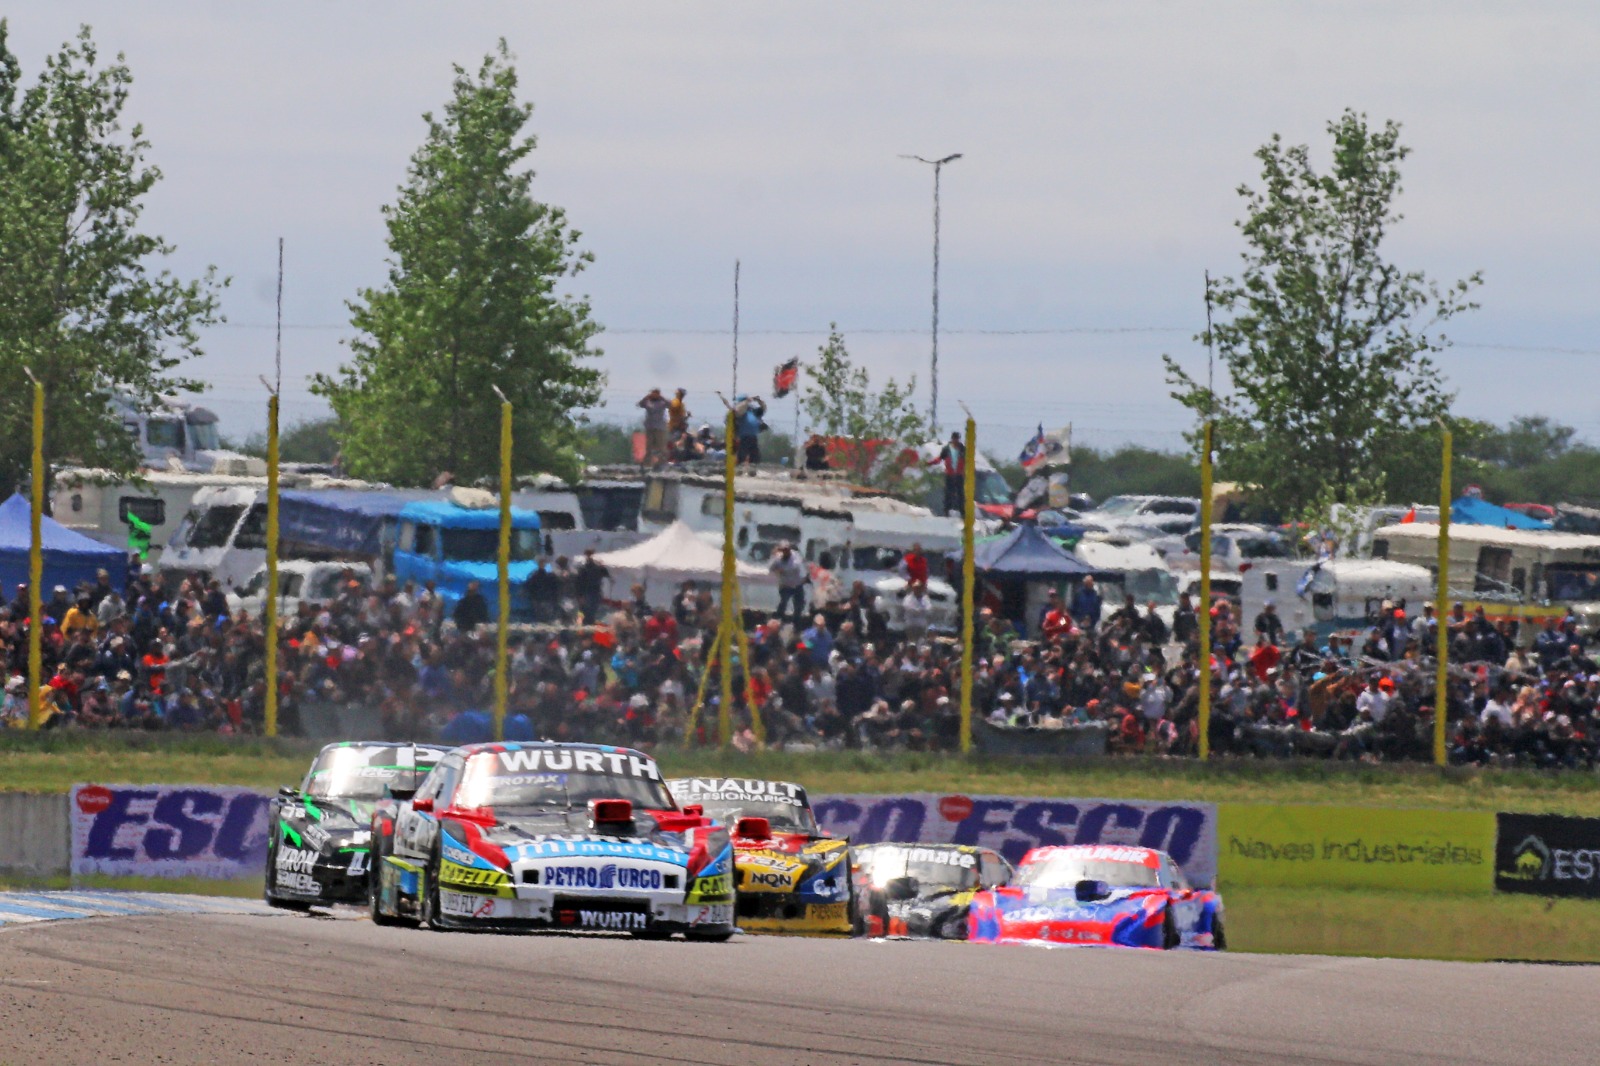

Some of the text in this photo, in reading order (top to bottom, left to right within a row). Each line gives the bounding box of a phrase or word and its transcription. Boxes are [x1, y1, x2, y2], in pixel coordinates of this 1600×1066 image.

[500, 749, 660, 781] WÜRTH
[664, 779, 802, 799] ENAULT
[84, 788, 270, 864] ESC
[544, 865, 598, 888] PETRO
[751, 873, 793, 888] NQN
